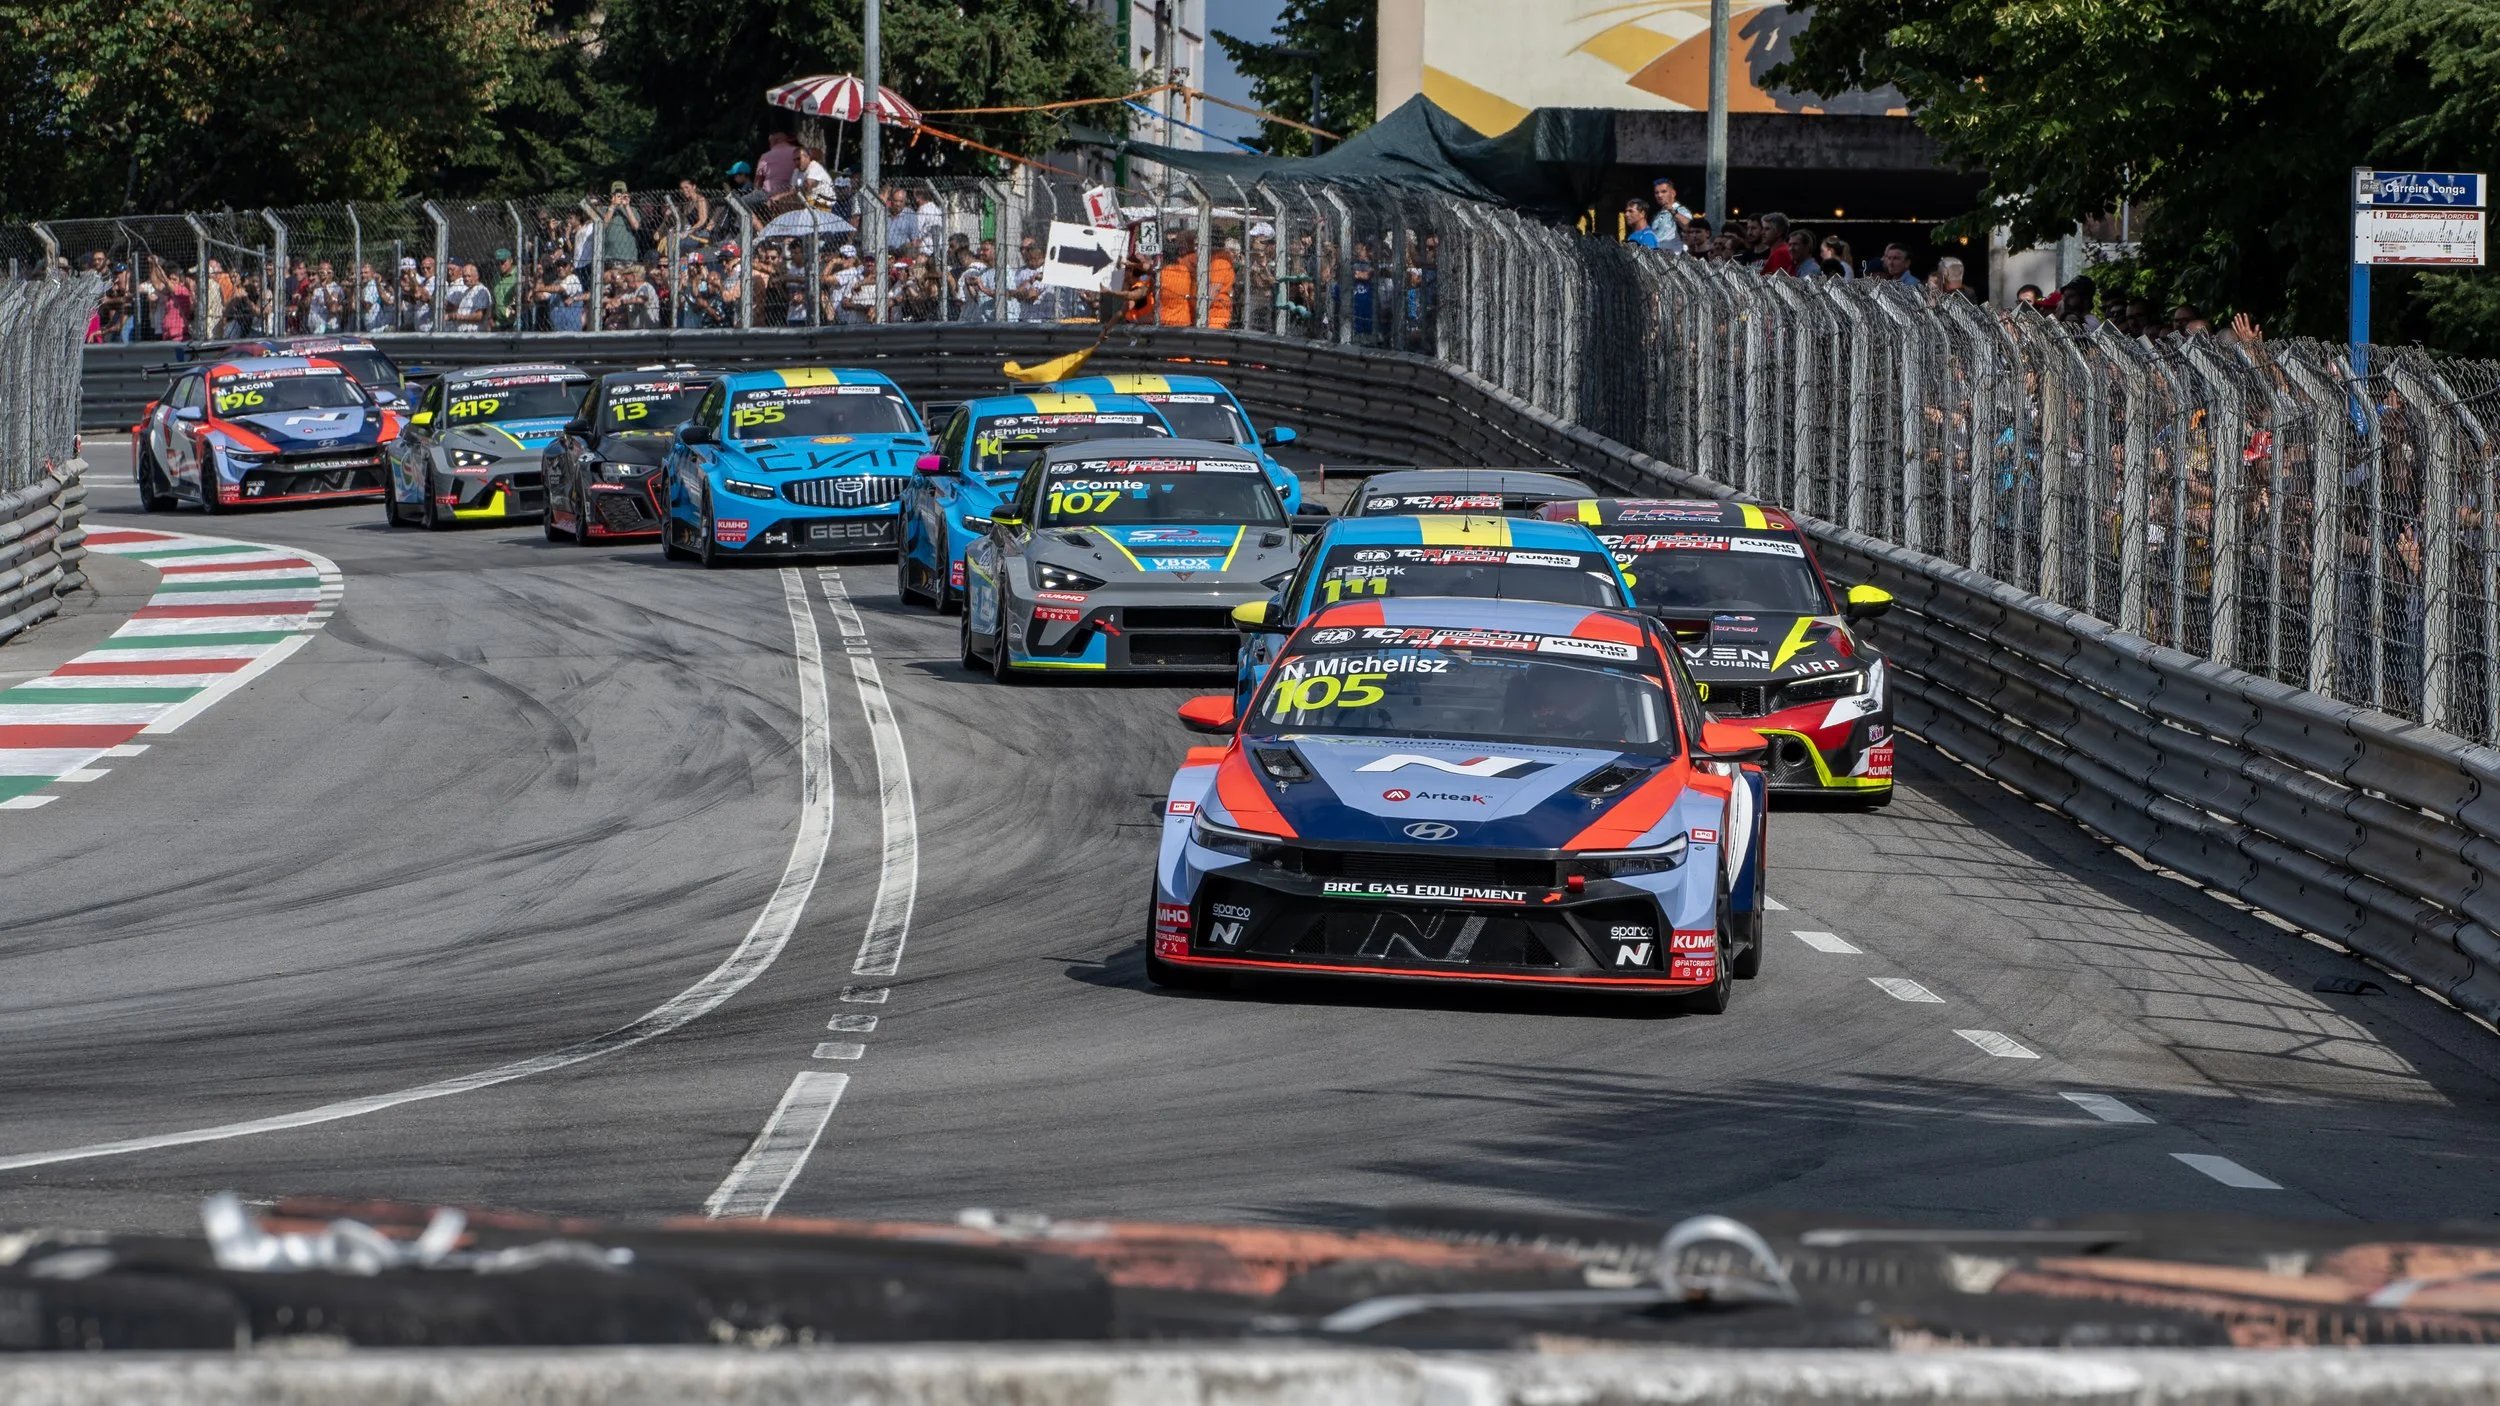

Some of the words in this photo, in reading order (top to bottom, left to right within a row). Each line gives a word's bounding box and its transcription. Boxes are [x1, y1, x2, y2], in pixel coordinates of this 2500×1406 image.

[2386, 183, 2429, 194] Carreira
[2432, 184, 2466, 195] Longa
[217, 387, 231, 397] M.
[232, 381, 275, 393] Azcona
[216, 392, 264, 412] 196
[451, 395, 461, 403] E.
[462, 391, 510, 400] Gianfratti
[449, 399, 500, 418] 419
[612, 402, 649, 422] 13
[734, 402, 754, 410] Ma
[756, 400, 784, 408] Qing
[732, 405, 786, 427] 155
[995, 417, 1018, 426] FIA
[978, 426, 1058, 438] Y.Ehrlacher
[1050, 463, 1078, 475] FIA
[1081, 460, 1128, 471] TCR
[1203, 462, 1253, 470] KUMHO
[1050, 480, 1144, 494] A.Comte
[1048, 491, 1121, 516] 107
[1367, 499, 1397, 509] FIA
[1402, 495, 1454, 505] TCR
[717, 521, 748, 530] KUMHO
[810, 521, 890, 540] GEELY
[1664, 541, 1723, 550] TOUR
[1739, 539, 1796, 551] KUMHO
[1776, 547, 1798, 555] TIRE
[1151, 558, 1209, 566] VBOX
[1356, 550, 1389, 562] FIA
[1394, 549, 1443, 558] TCR
[1514, 554, 1571, 563] KUMHO
[1334, 565, 1406, 577] T.Björk
[1322, 577, 1387, 603] 111
[1038, 593, 1085, 602] KUMHO
[1313, 629, 1352, 643] FIA
[1361, 627, 1434, 639] TCR
[1443, 630, 1514, 640] WORLD
[1450, 638, 1528, 650] TOUR
[1552, 639, 1628, 653] KUMHO
[1682, 647, 1769, 662] VEN
[1284, 655, 1449, 680] N.Michelisz
[1687, 659, 1704, 667] AL
[1710, 660, 1770, 670] CUISINE
[1791, 660, 1840, 676] NRP
[1275, 673, 1388, 714] 105
[1459, 743, 1583, 757] MOTORSPORT
[1324, 882, 1362, 893] BRC
[1369, 884, 1408, 895] GAS
[1415, 885, 1527, 902] EQUIPMENT
[1157, 909, 1189, 923] MHO
[1213, 903, 1251, 919] sparco
[1156, 932, 1187, 943] WORLDTOUR
[1611, 926, 1653, 940] sparco
